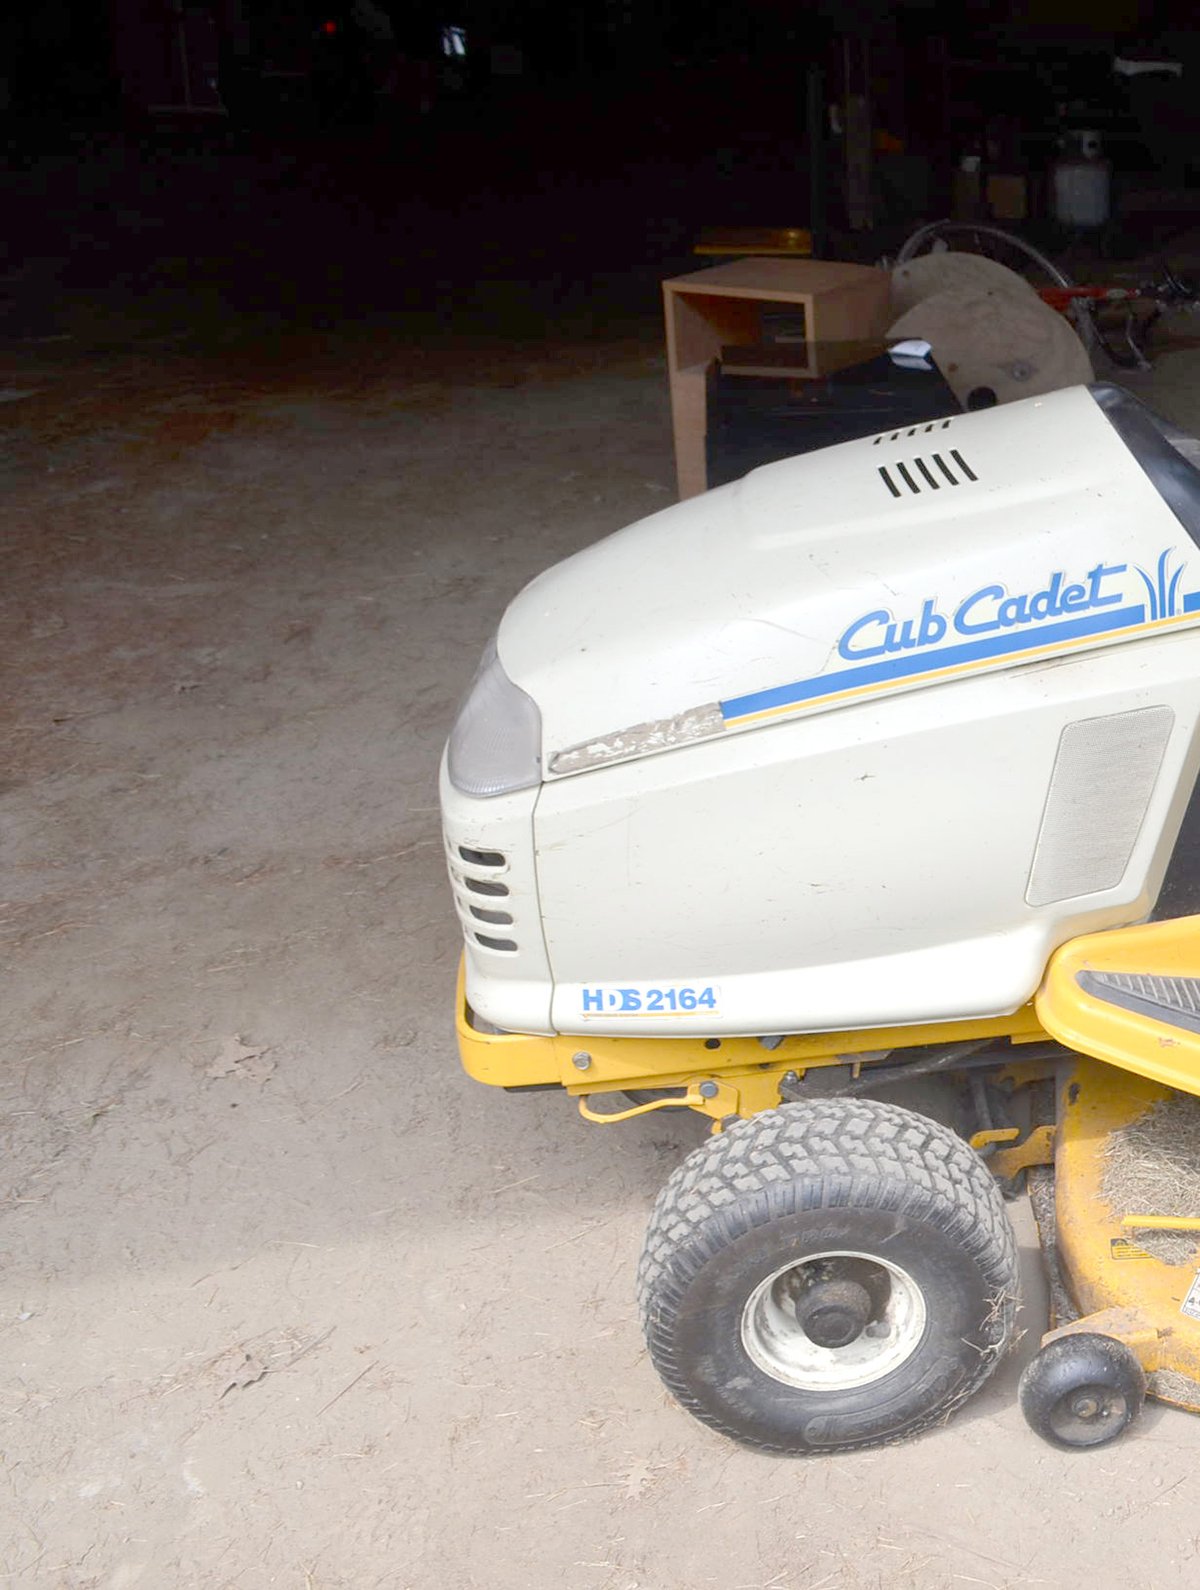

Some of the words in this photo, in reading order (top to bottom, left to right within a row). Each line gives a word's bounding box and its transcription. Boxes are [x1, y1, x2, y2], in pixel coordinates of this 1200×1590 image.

[838, 600, 947, 661] Cub
[953, 563, 1128, 636] Cadet
[582, 988, 642, 1011] HDS
[646, 987, 717, 1011] 2164
